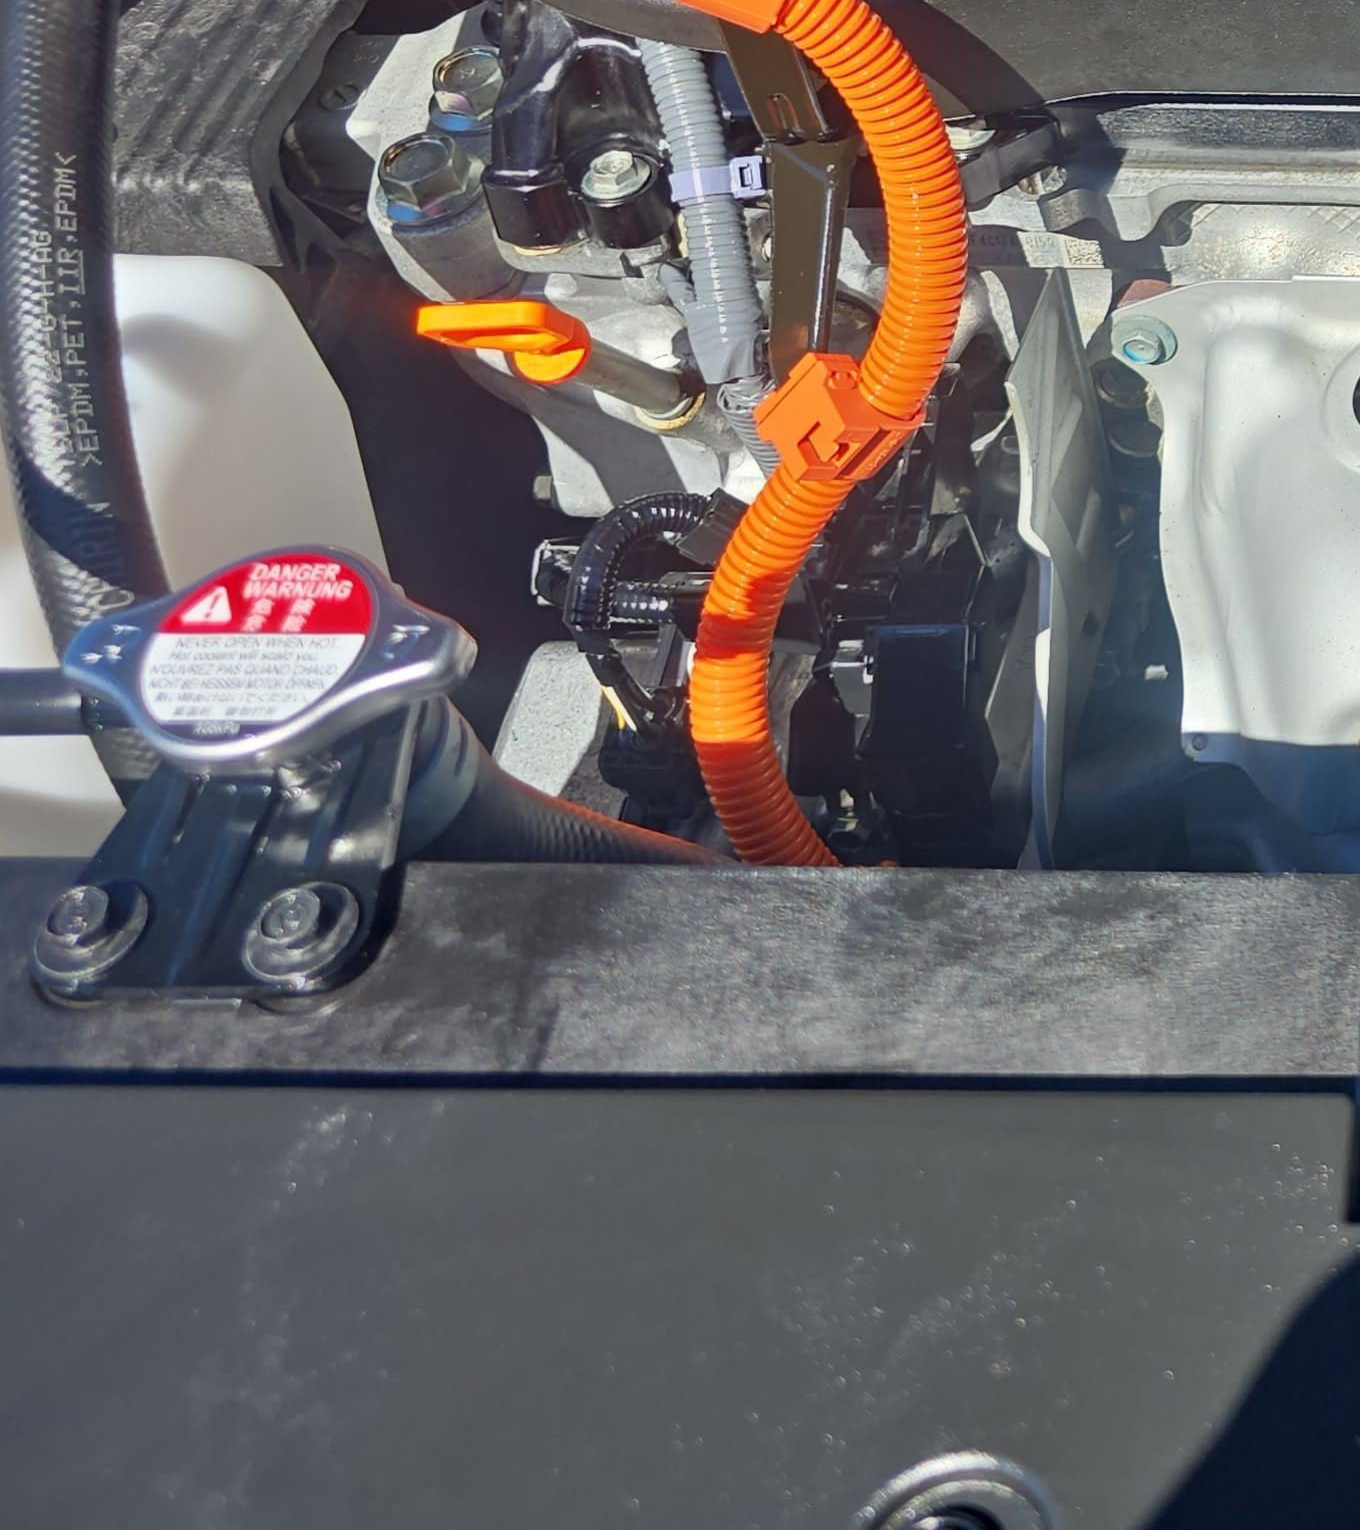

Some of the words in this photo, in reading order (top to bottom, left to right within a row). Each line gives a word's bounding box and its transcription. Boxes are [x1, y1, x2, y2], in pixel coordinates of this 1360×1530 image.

[249, 563, 341, 581] DANGER
[242, 581, 353, 599] WARNUNG
[176, 637, 224, 648] NEVER
[225, 637, 260, 648] OPEN
[265, 637, 304, 648] WHEN
[309, 637, 338, 648] HOT
[218, 664, 242, 675] PAS
